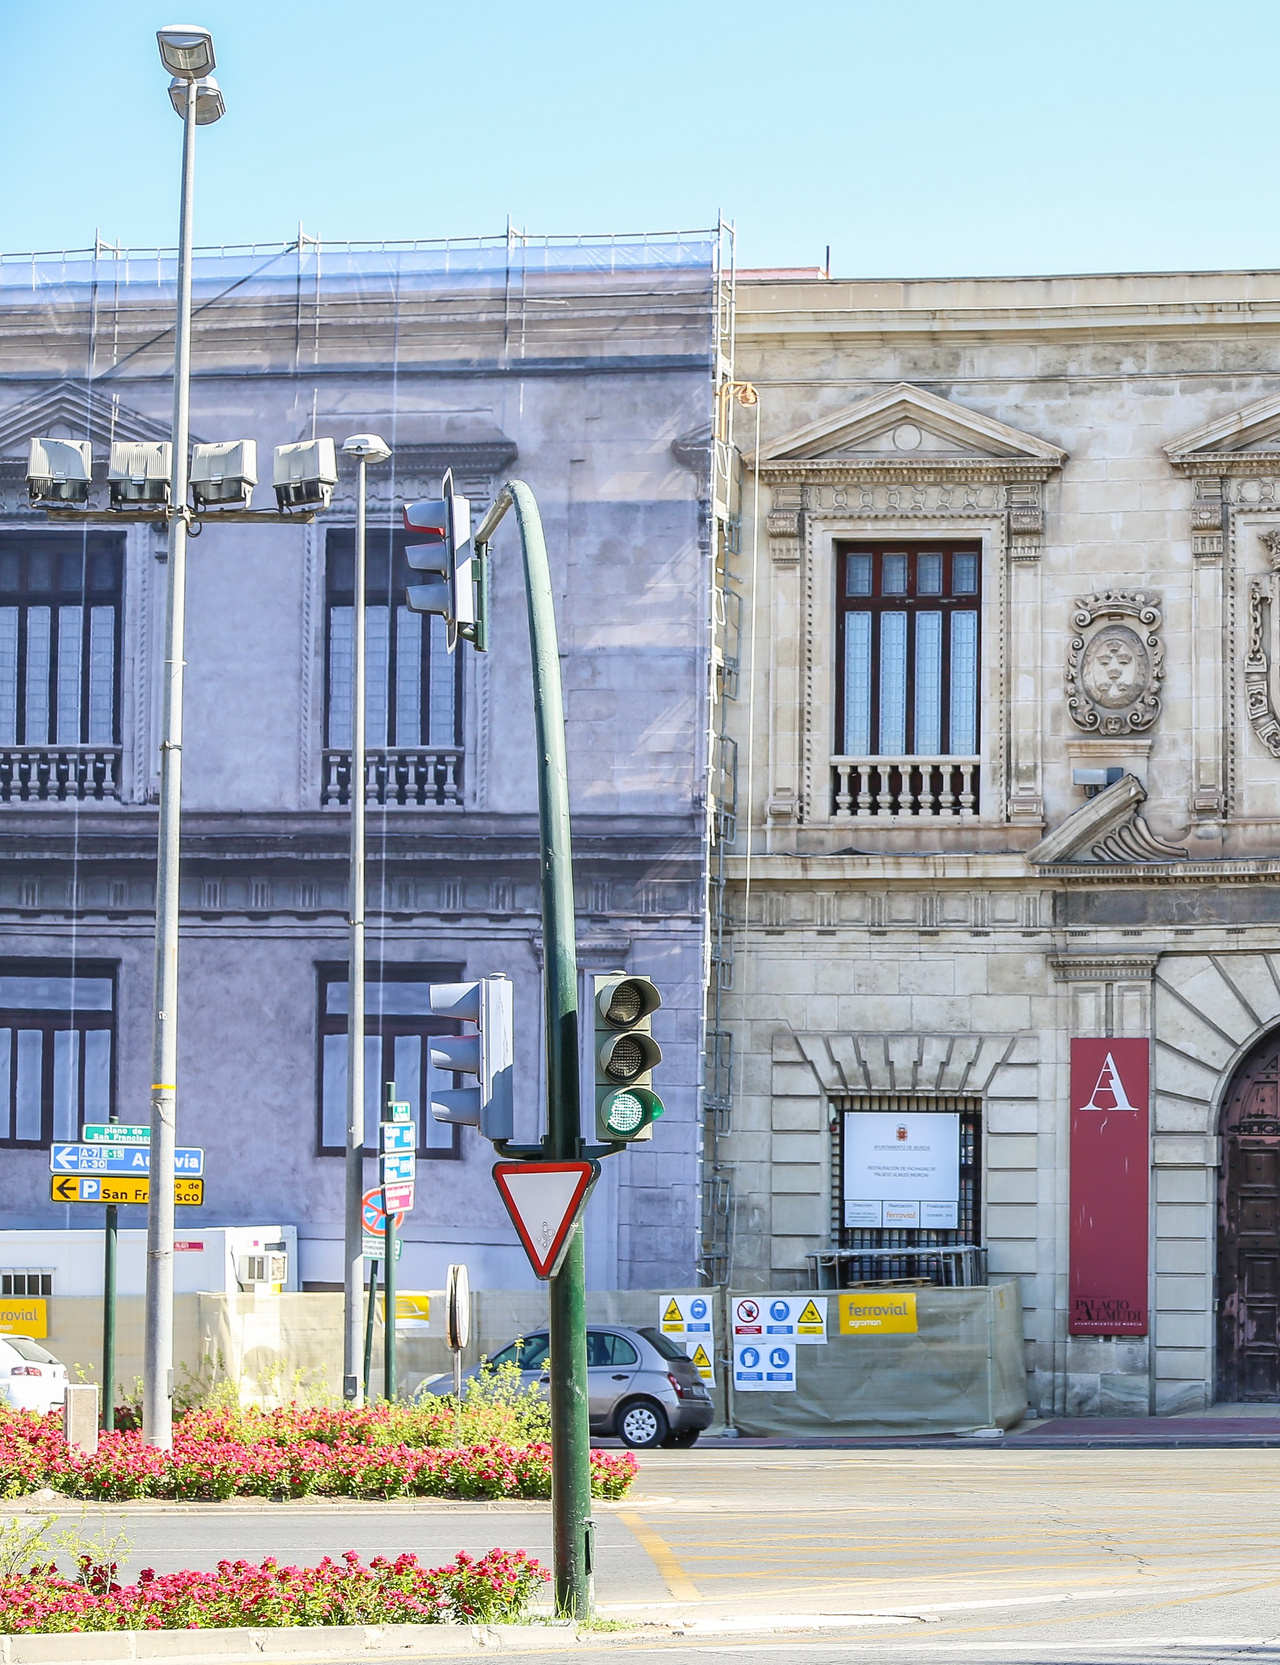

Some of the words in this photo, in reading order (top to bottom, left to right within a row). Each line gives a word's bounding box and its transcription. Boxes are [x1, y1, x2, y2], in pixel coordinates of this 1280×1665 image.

[1079, 1052, 1139, 1111] A
[93, 1132, 110, 1140] San
[104, 1127, 128, 1136] plano
[81, 1149, 98, 1157] A-7
[103, 1149, 123, 1158] E-15
[81, 1160, 105, 1168] A-30
[83, 1181, 98, 1198] P
[188, 1182, 199, 1190] de
[102, 1189, 128, 1200] San
[886, 1211, 916, 1219] ferrovial
[848, 1302, 908, 1316] ferrovial
[1075, 1300, 1129, 1310] PALACIO
